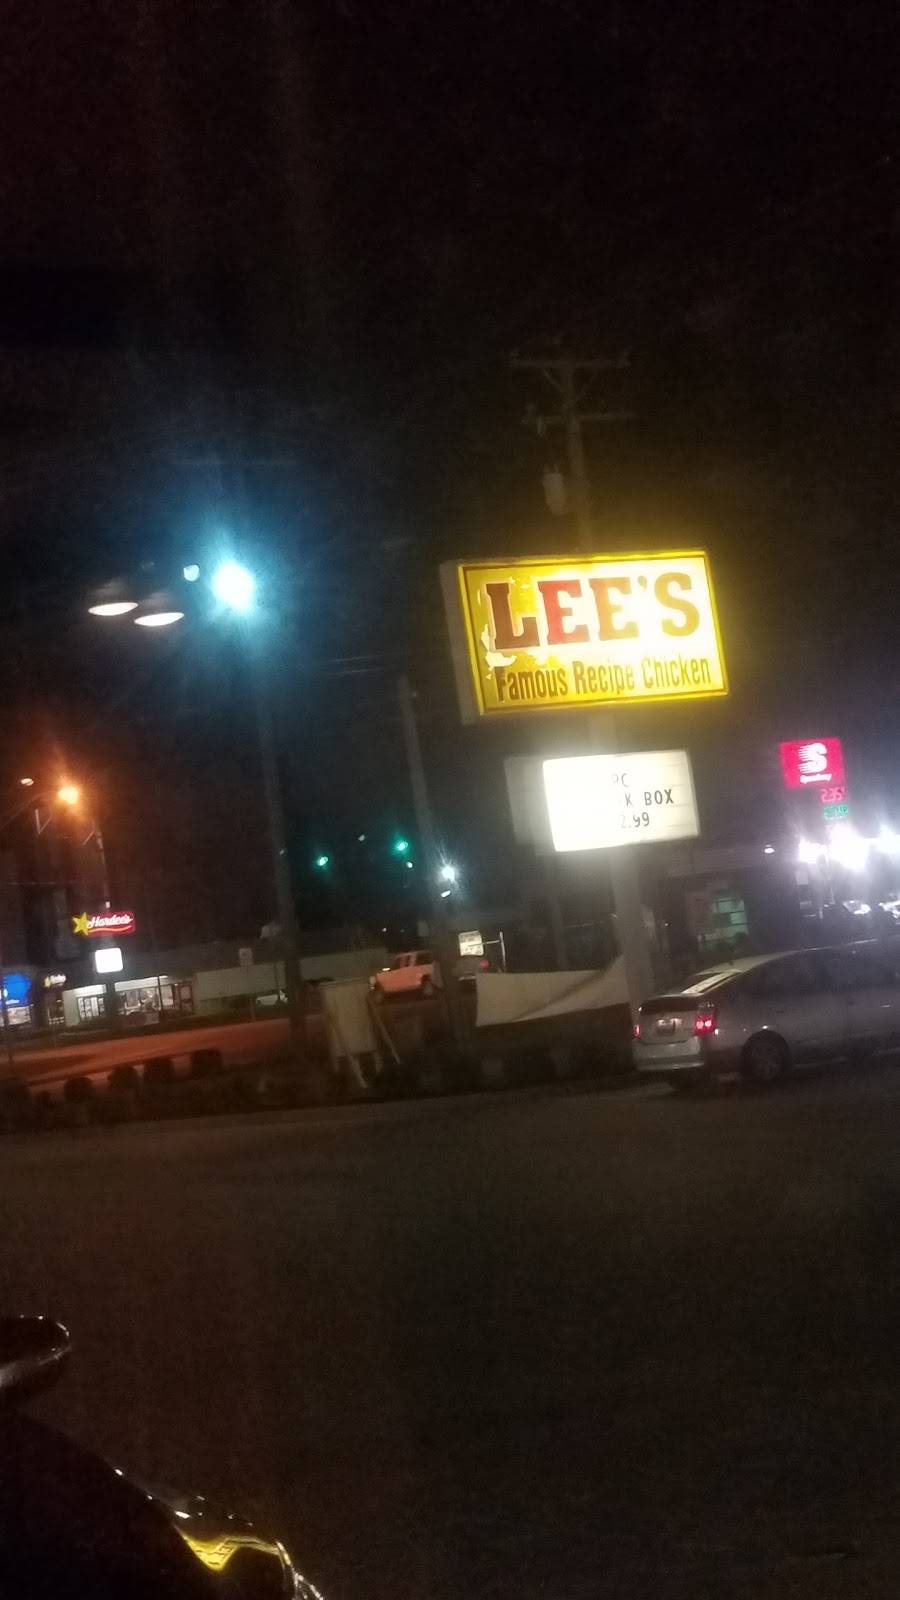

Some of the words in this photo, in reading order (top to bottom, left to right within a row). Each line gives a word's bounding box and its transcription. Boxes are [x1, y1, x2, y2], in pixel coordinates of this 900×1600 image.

[486, 572, 700, 650] LEE'S
[494, 667, 568, 702] Famous
[572, 660, 635, 694] Recipe
[642, 654, 712, 688] Chicken
[643, 788, 675, 807] BOX
